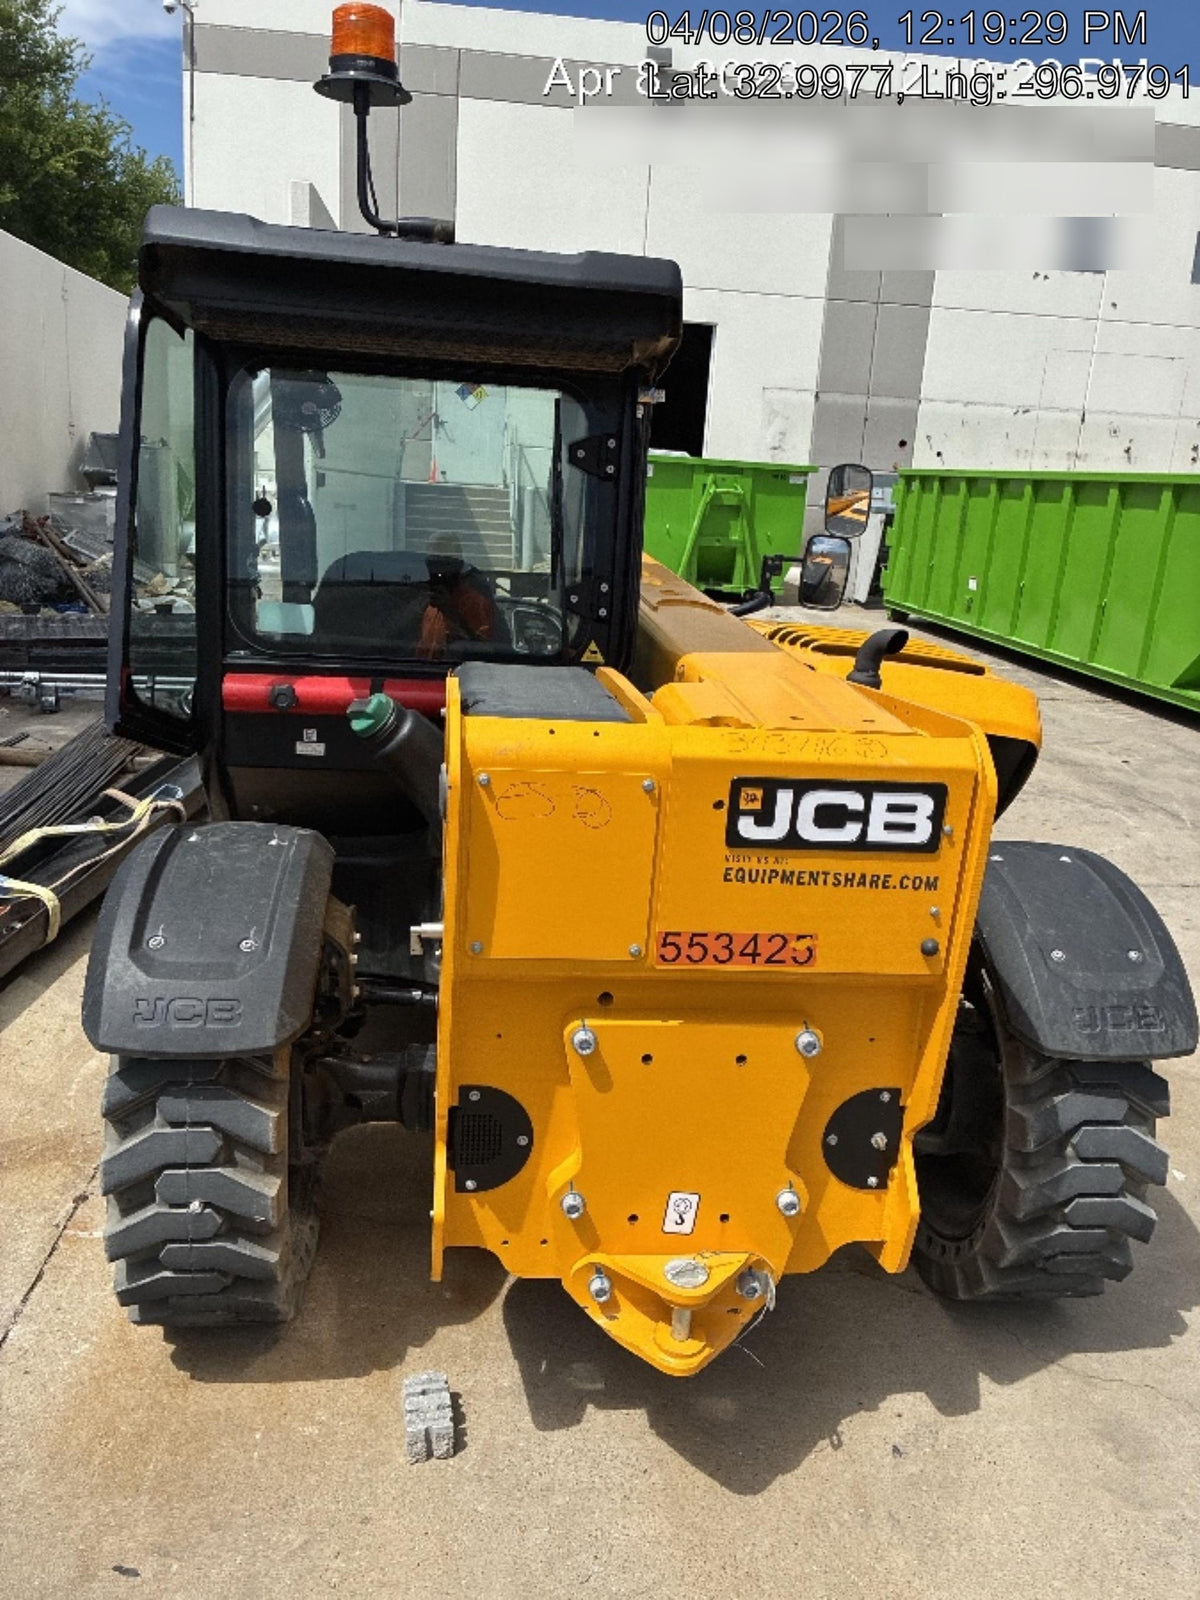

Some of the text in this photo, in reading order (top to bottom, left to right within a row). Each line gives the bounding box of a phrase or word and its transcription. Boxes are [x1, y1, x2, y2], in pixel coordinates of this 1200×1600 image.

[736, 788, 935, 845] JCB
[722, 867, 940, 892] EQUIPMENTSHARE.COM
[658, 931, 814, 966] 553425
[132, 996, 244, 1029] JCB
[1071, 1004, 1166, 1034] JCB
